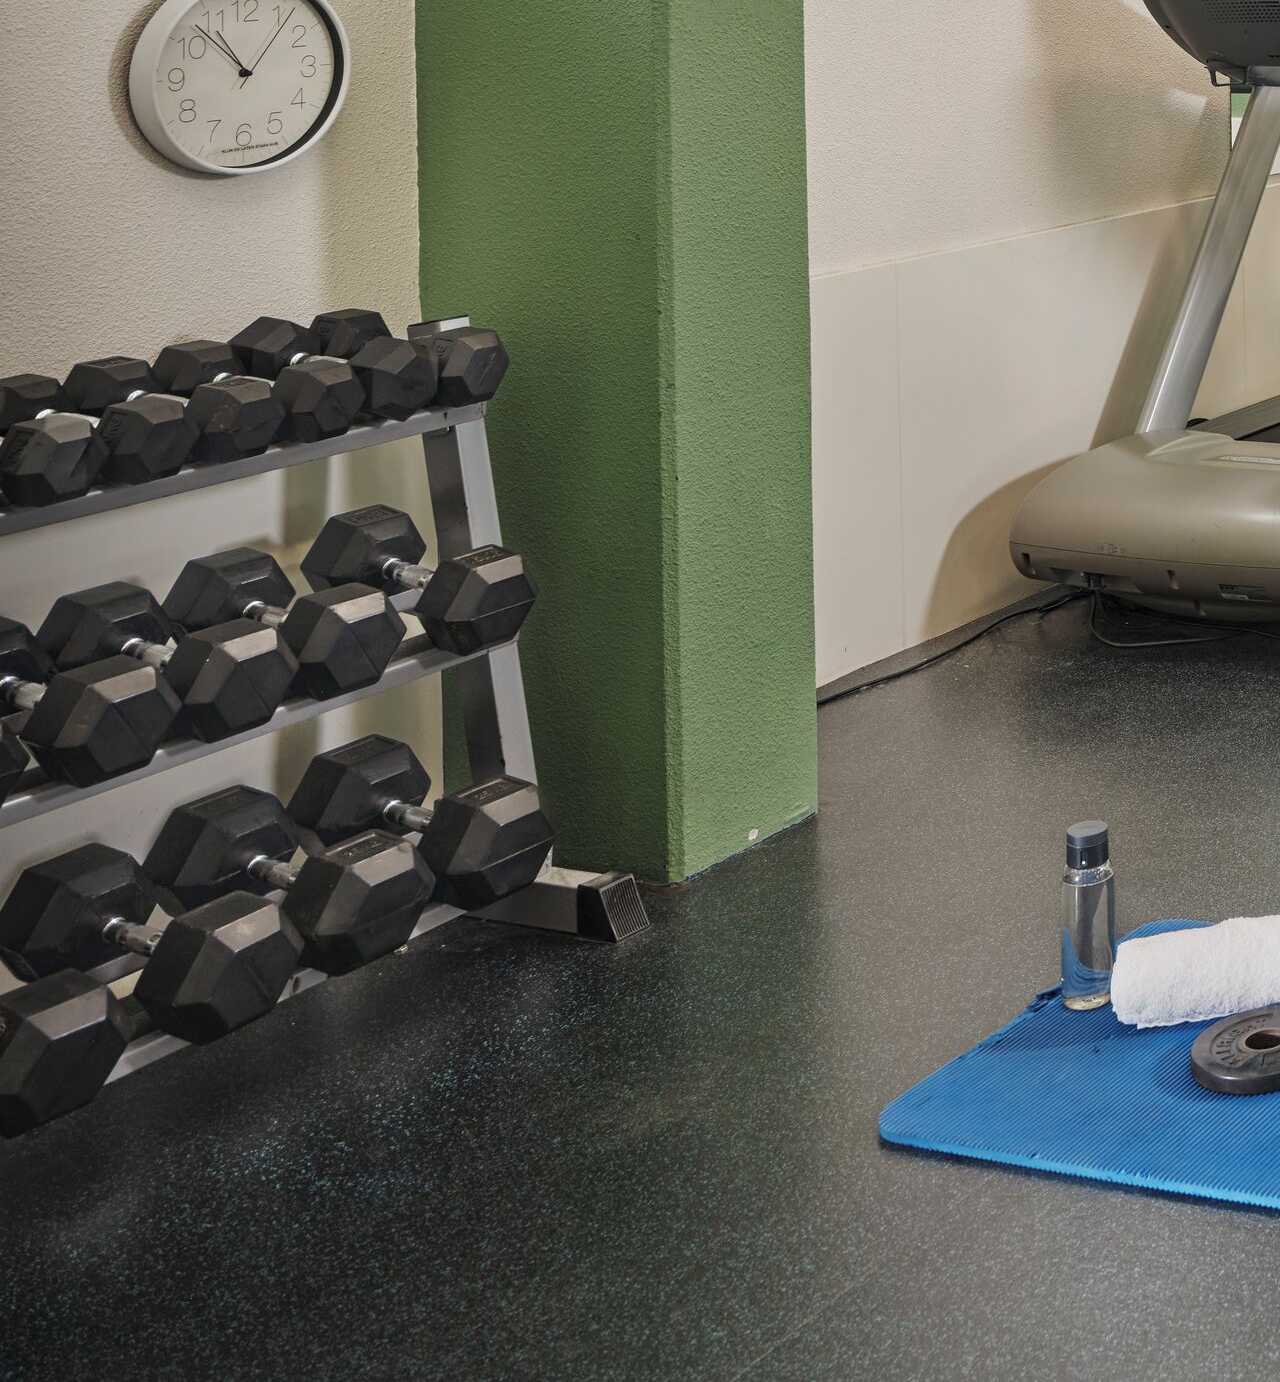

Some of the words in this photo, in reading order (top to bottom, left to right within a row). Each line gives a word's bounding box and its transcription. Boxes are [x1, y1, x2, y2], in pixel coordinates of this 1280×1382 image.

[202, 9, 224, 33] 11
[272, 5, 281, 27] 1
[177, 35, 207, 60] 10
[291, 25, 307, 48] 2
[300, 55, 317, 78] 3
[167, 67, 185, 92] 9
[290, 87, 307, 109] 4
[178, 99, 197, 123] 8
[267, 111, 282, 135] 5
[206, 120, 221, 143] 7
[235, 123, 252, 147] 6
